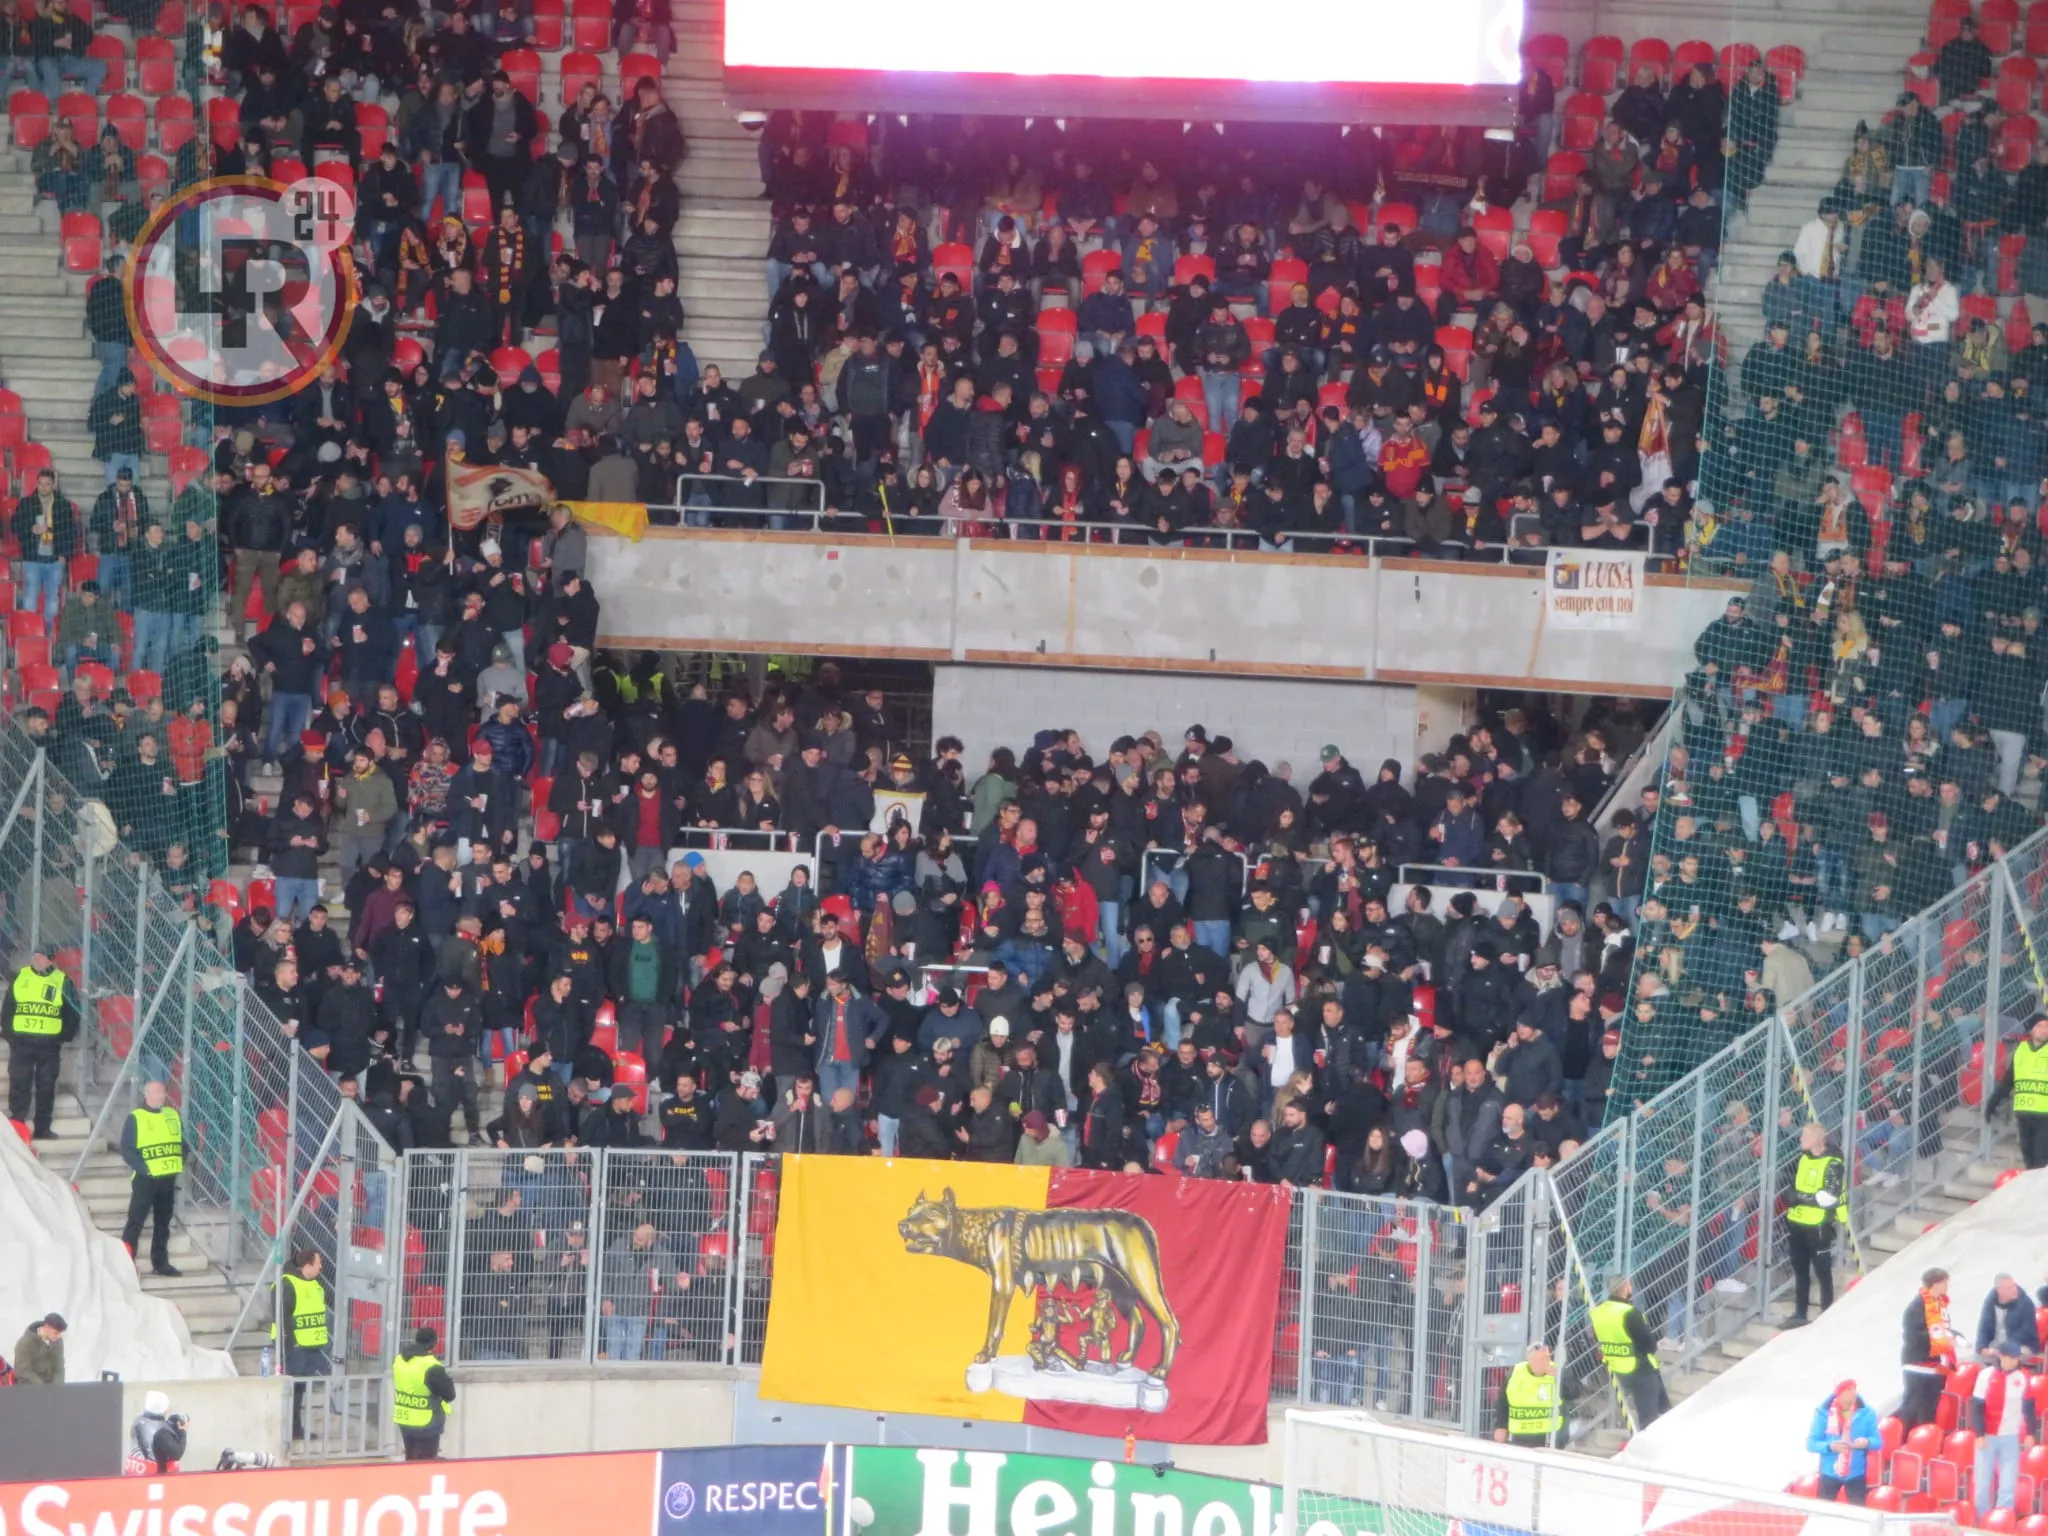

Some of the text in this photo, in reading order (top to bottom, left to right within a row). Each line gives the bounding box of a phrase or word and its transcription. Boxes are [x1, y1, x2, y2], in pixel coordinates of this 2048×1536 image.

[1584, 560, 1633, 589] LUISA
[1555, 595, 1594, 616] sempre
[1617, 597, 1633, 613] noi
[24, 1018, 45, 1030] 371
[1472, 1463, 1509, 1507] 18
